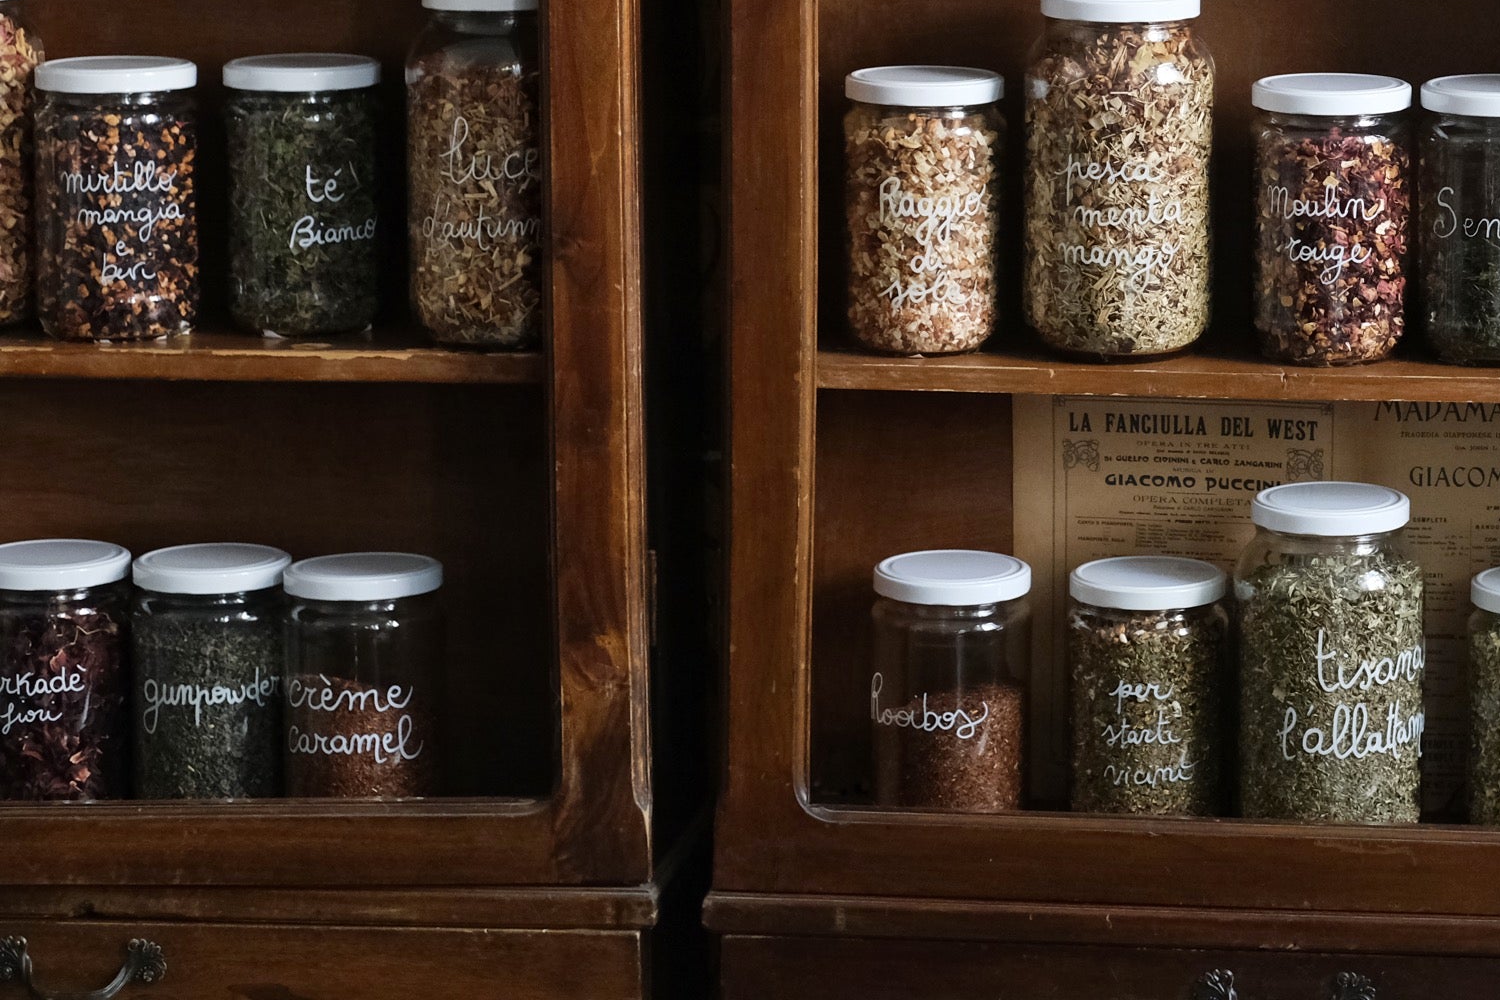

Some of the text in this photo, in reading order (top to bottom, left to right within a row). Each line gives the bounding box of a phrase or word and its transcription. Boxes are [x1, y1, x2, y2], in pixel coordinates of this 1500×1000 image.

[60, 162, 178, 196] mirtillo
[1058, 153, 1166, 207] pesca
[77, 200, 185, 243] mangia
[879, 176, 988, 247] Raggio
[1072, 195, 1189, 228] menta
[1266, 183, 1386, 222] Moulin
[114, 238, 128, 258] e
[288, 212, 379, 252] Bianco
[421, 204, 542, 254] d'autunn
[907, 243, 948, 274] di
[1056, 241, 1181, 295] mango
[1285, 238, 1374, 286] rouge
[1068, 411, 1319, 442] LA FANCIULLA DEL WEST
[1104, 472, 1198, 489] GIACOMO
[1199, 457, 1230, 467] CARLO
[1232, 459, 1283, 470] ZANGARINI
[1132, 494, 1177, 505] OPERA
[0, 664, 88, 697] rkadè
[1314, 629, 1426, 693] tisana
[143, 666, 282, 734] gunpowder
[288, 673, 414, 712] crème
[869, 670, 990, 740] Rooibos
[1108, 680, 1176, 715] per
[288, 714, 424, 764] caramel
[1276, 699, 1426, 761] l'allattam
